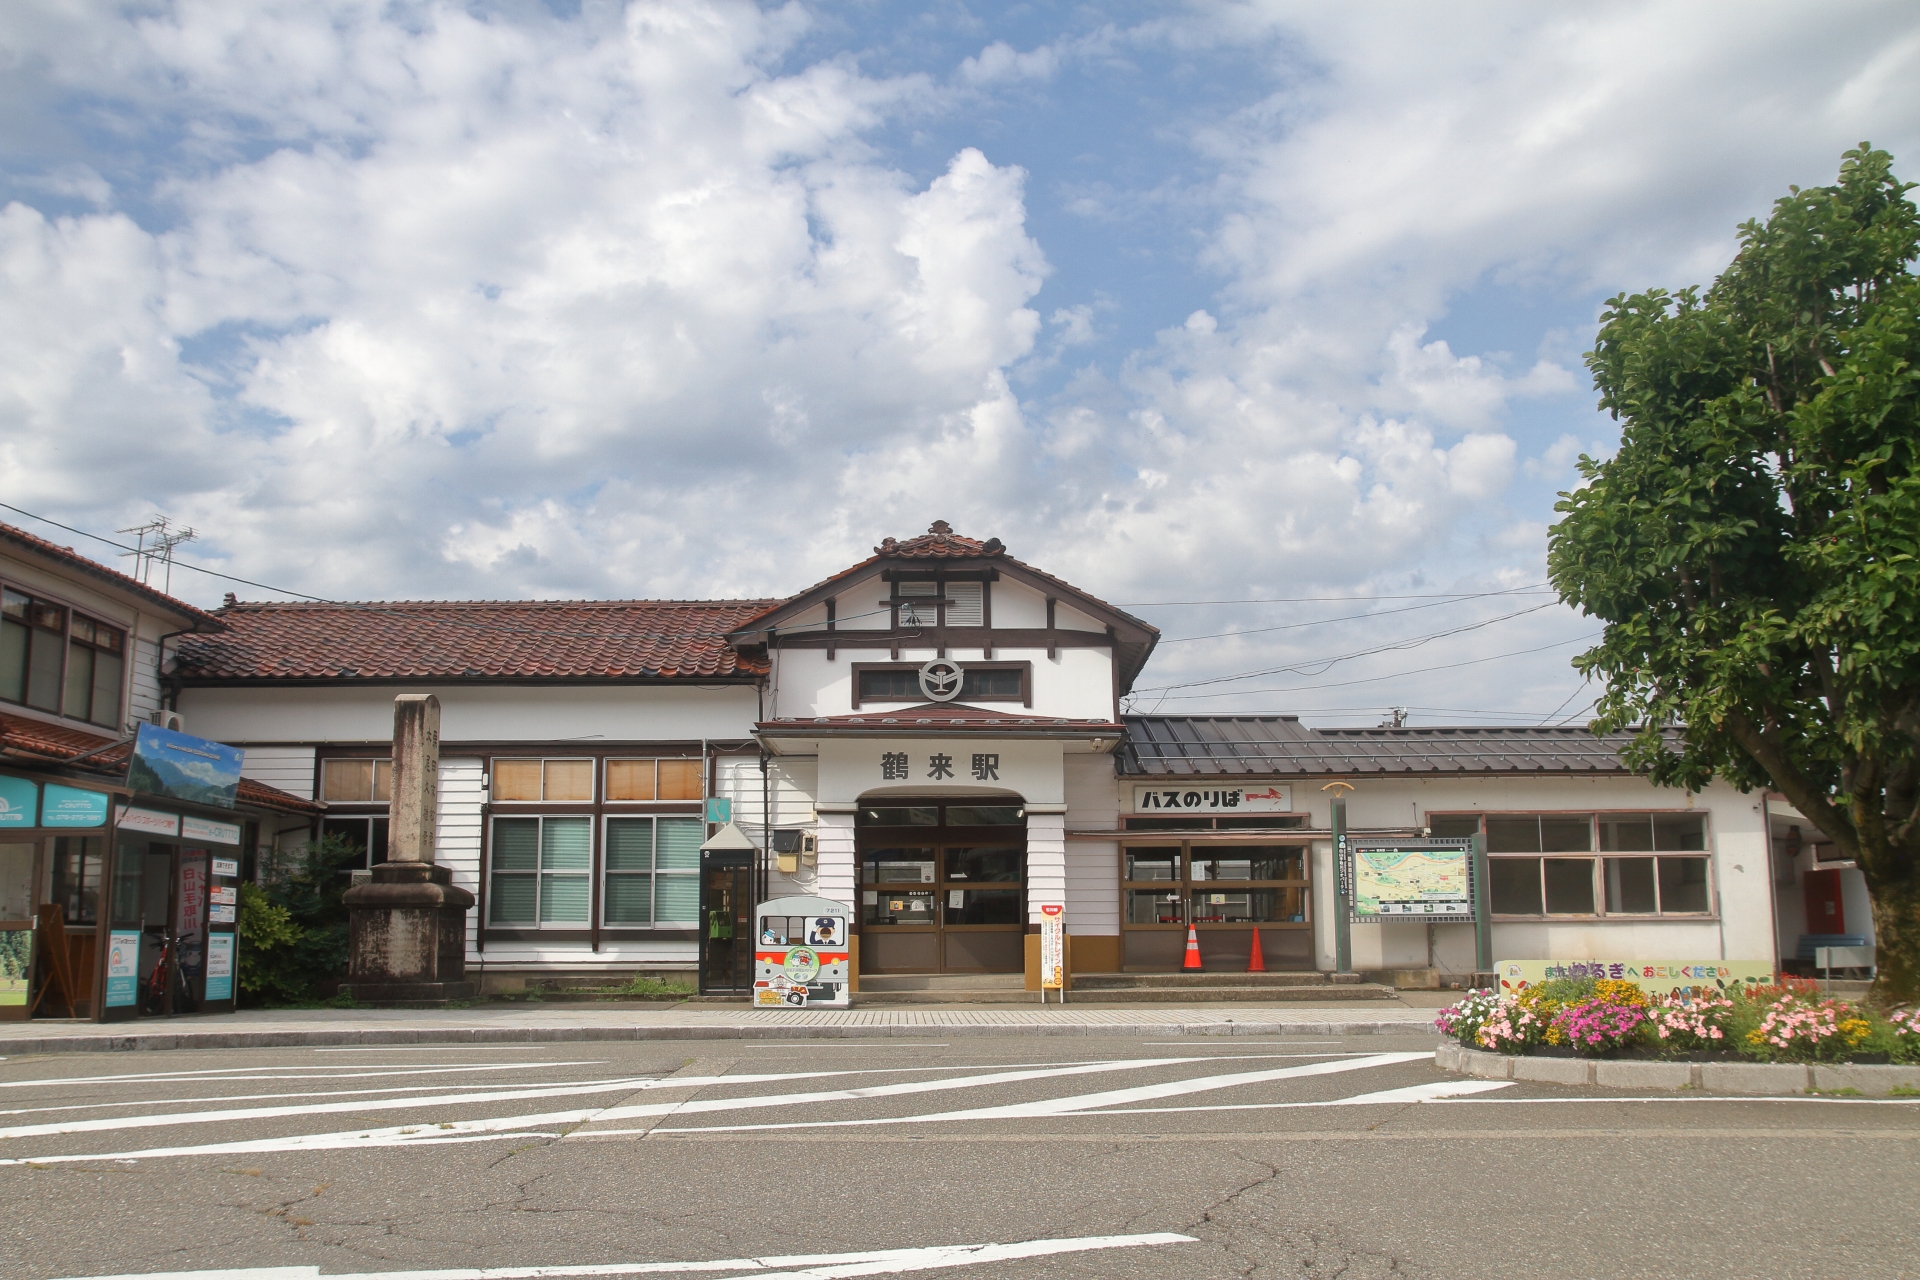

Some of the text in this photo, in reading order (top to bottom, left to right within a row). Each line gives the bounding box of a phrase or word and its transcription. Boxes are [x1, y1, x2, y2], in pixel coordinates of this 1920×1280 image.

[880, 752, 999, 780] 鶴来駅
[1142, 789, 1243, 808] バスのりば
